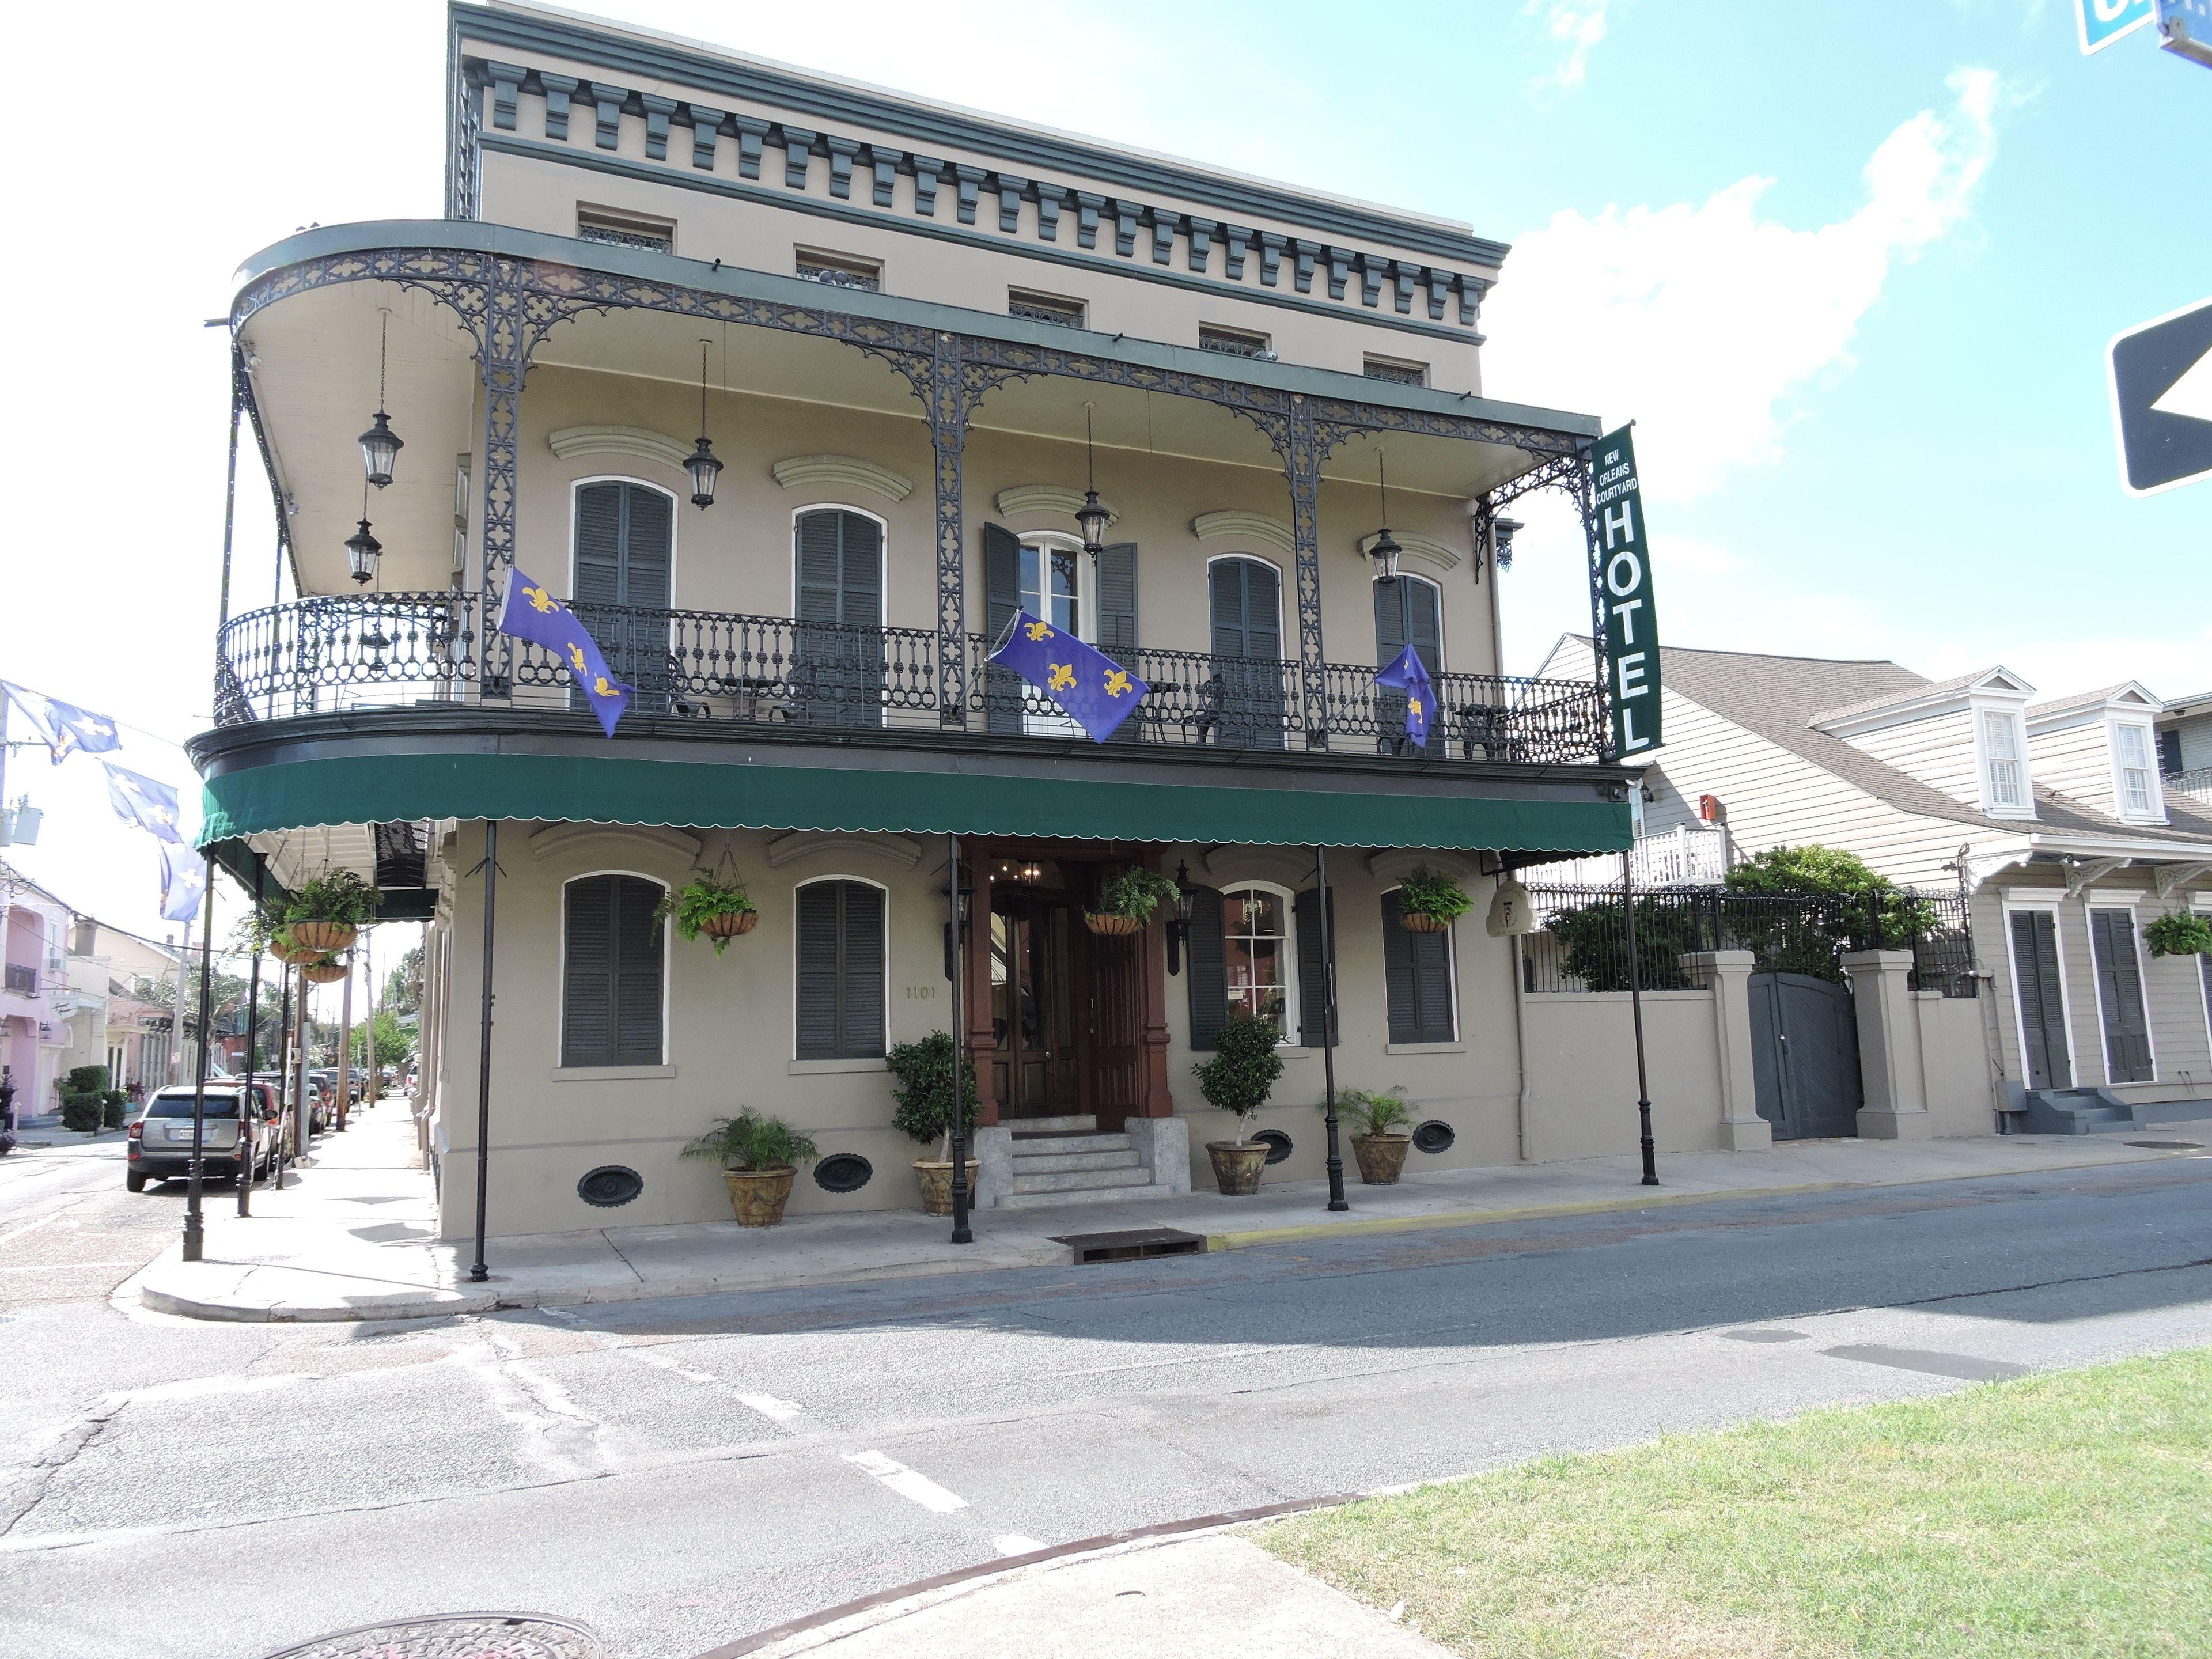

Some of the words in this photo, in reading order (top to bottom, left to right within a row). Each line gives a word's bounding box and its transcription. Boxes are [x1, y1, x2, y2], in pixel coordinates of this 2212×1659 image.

[1604, 449, 1619, 467] NEW
[1599, 462, 1630, 486] ORLEANS
[1596, 478, 1637, 505] COURTYARD
[1605, 500, 1649, 751] HOTEL
[907, 985, 935, 999] 1101
